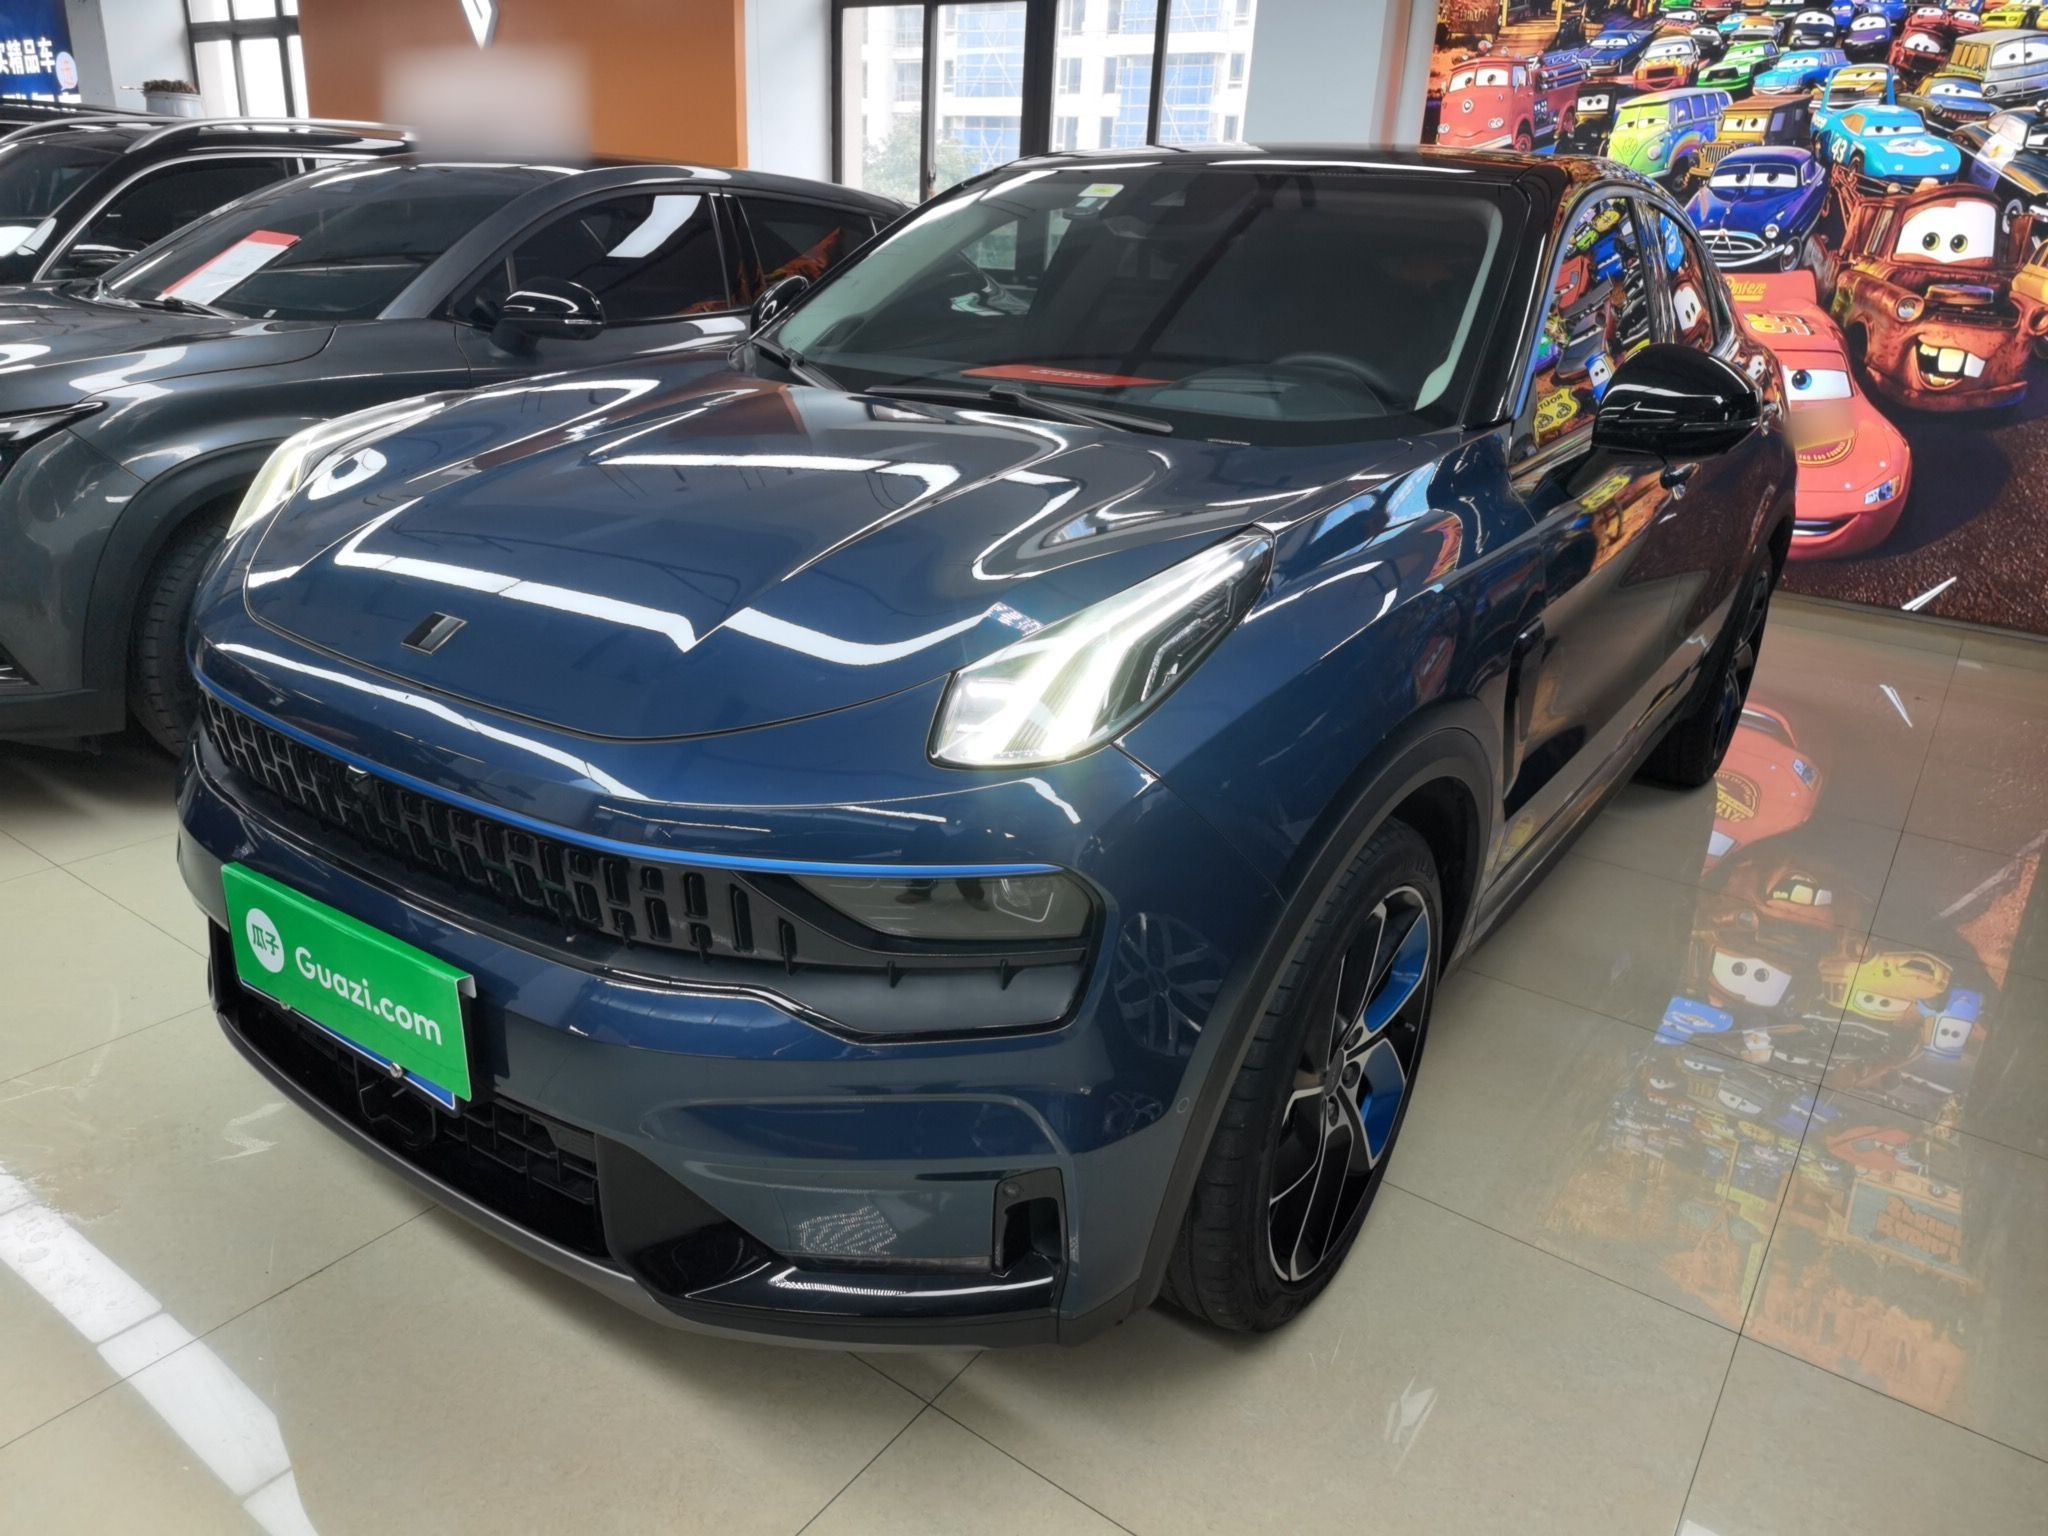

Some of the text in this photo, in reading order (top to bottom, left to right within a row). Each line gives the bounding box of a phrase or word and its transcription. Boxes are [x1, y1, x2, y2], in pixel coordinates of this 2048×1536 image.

[1831, 137, 1848, 163] 43
[251, 923, 280, 956] 瓜子
[295, 946, 442, 1046] Guazi.com
